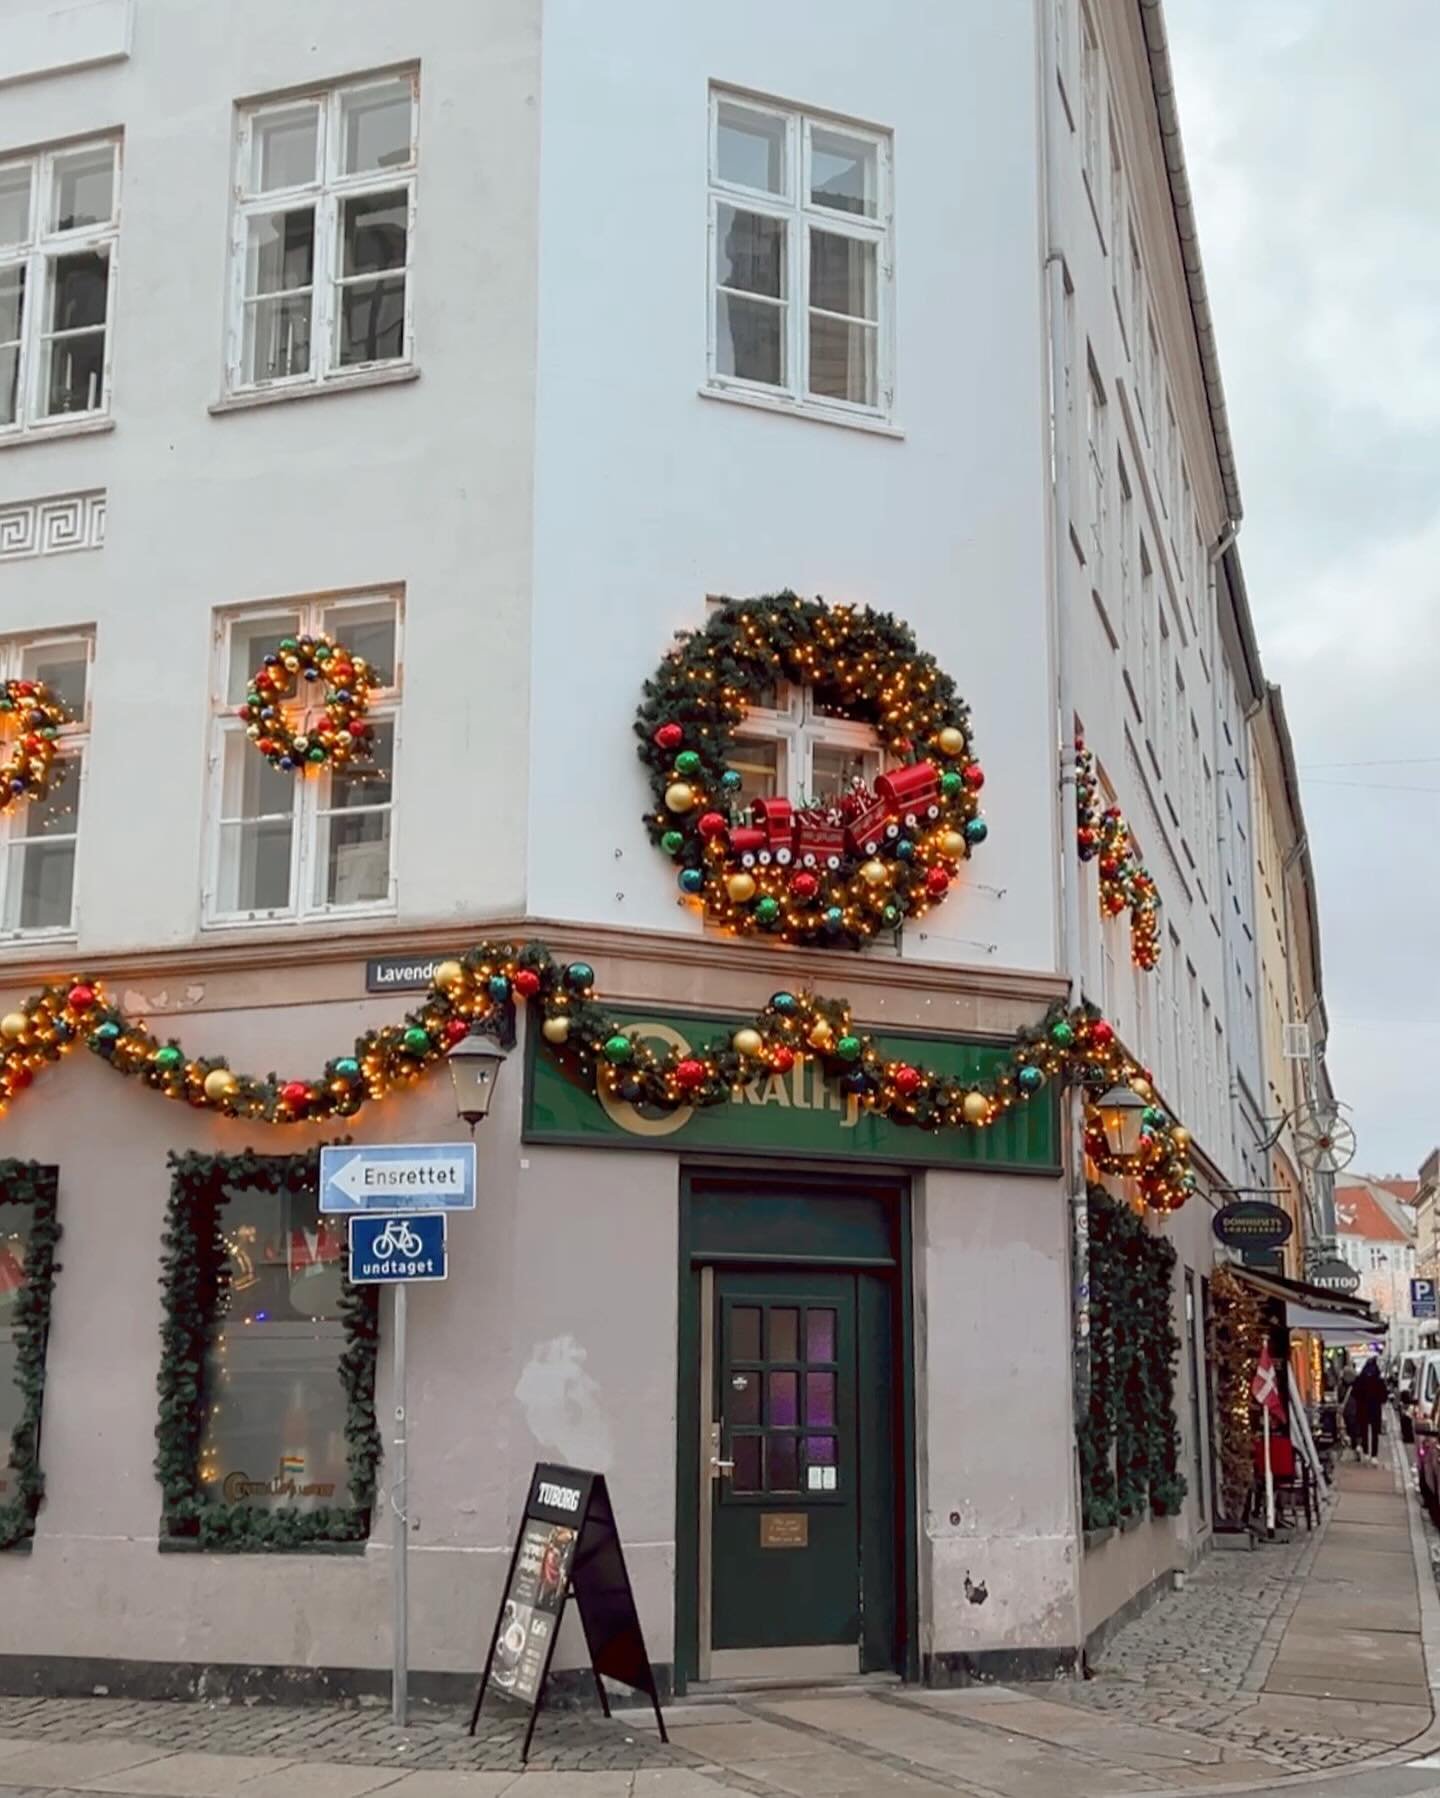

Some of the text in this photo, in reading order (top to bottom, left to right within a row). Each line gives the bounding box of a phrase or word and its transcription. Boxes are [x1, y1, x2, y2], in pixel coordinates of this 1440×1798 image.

[364, 1166, 456, 1185] Ensrettet
[362, 1259, 433, 1275] undtaget
[1313, 1277, 1358, 1288] TATTOO
[1415, 1281, 1430, 1300] P
[537, 1482, 581, 1512] TUBORG
